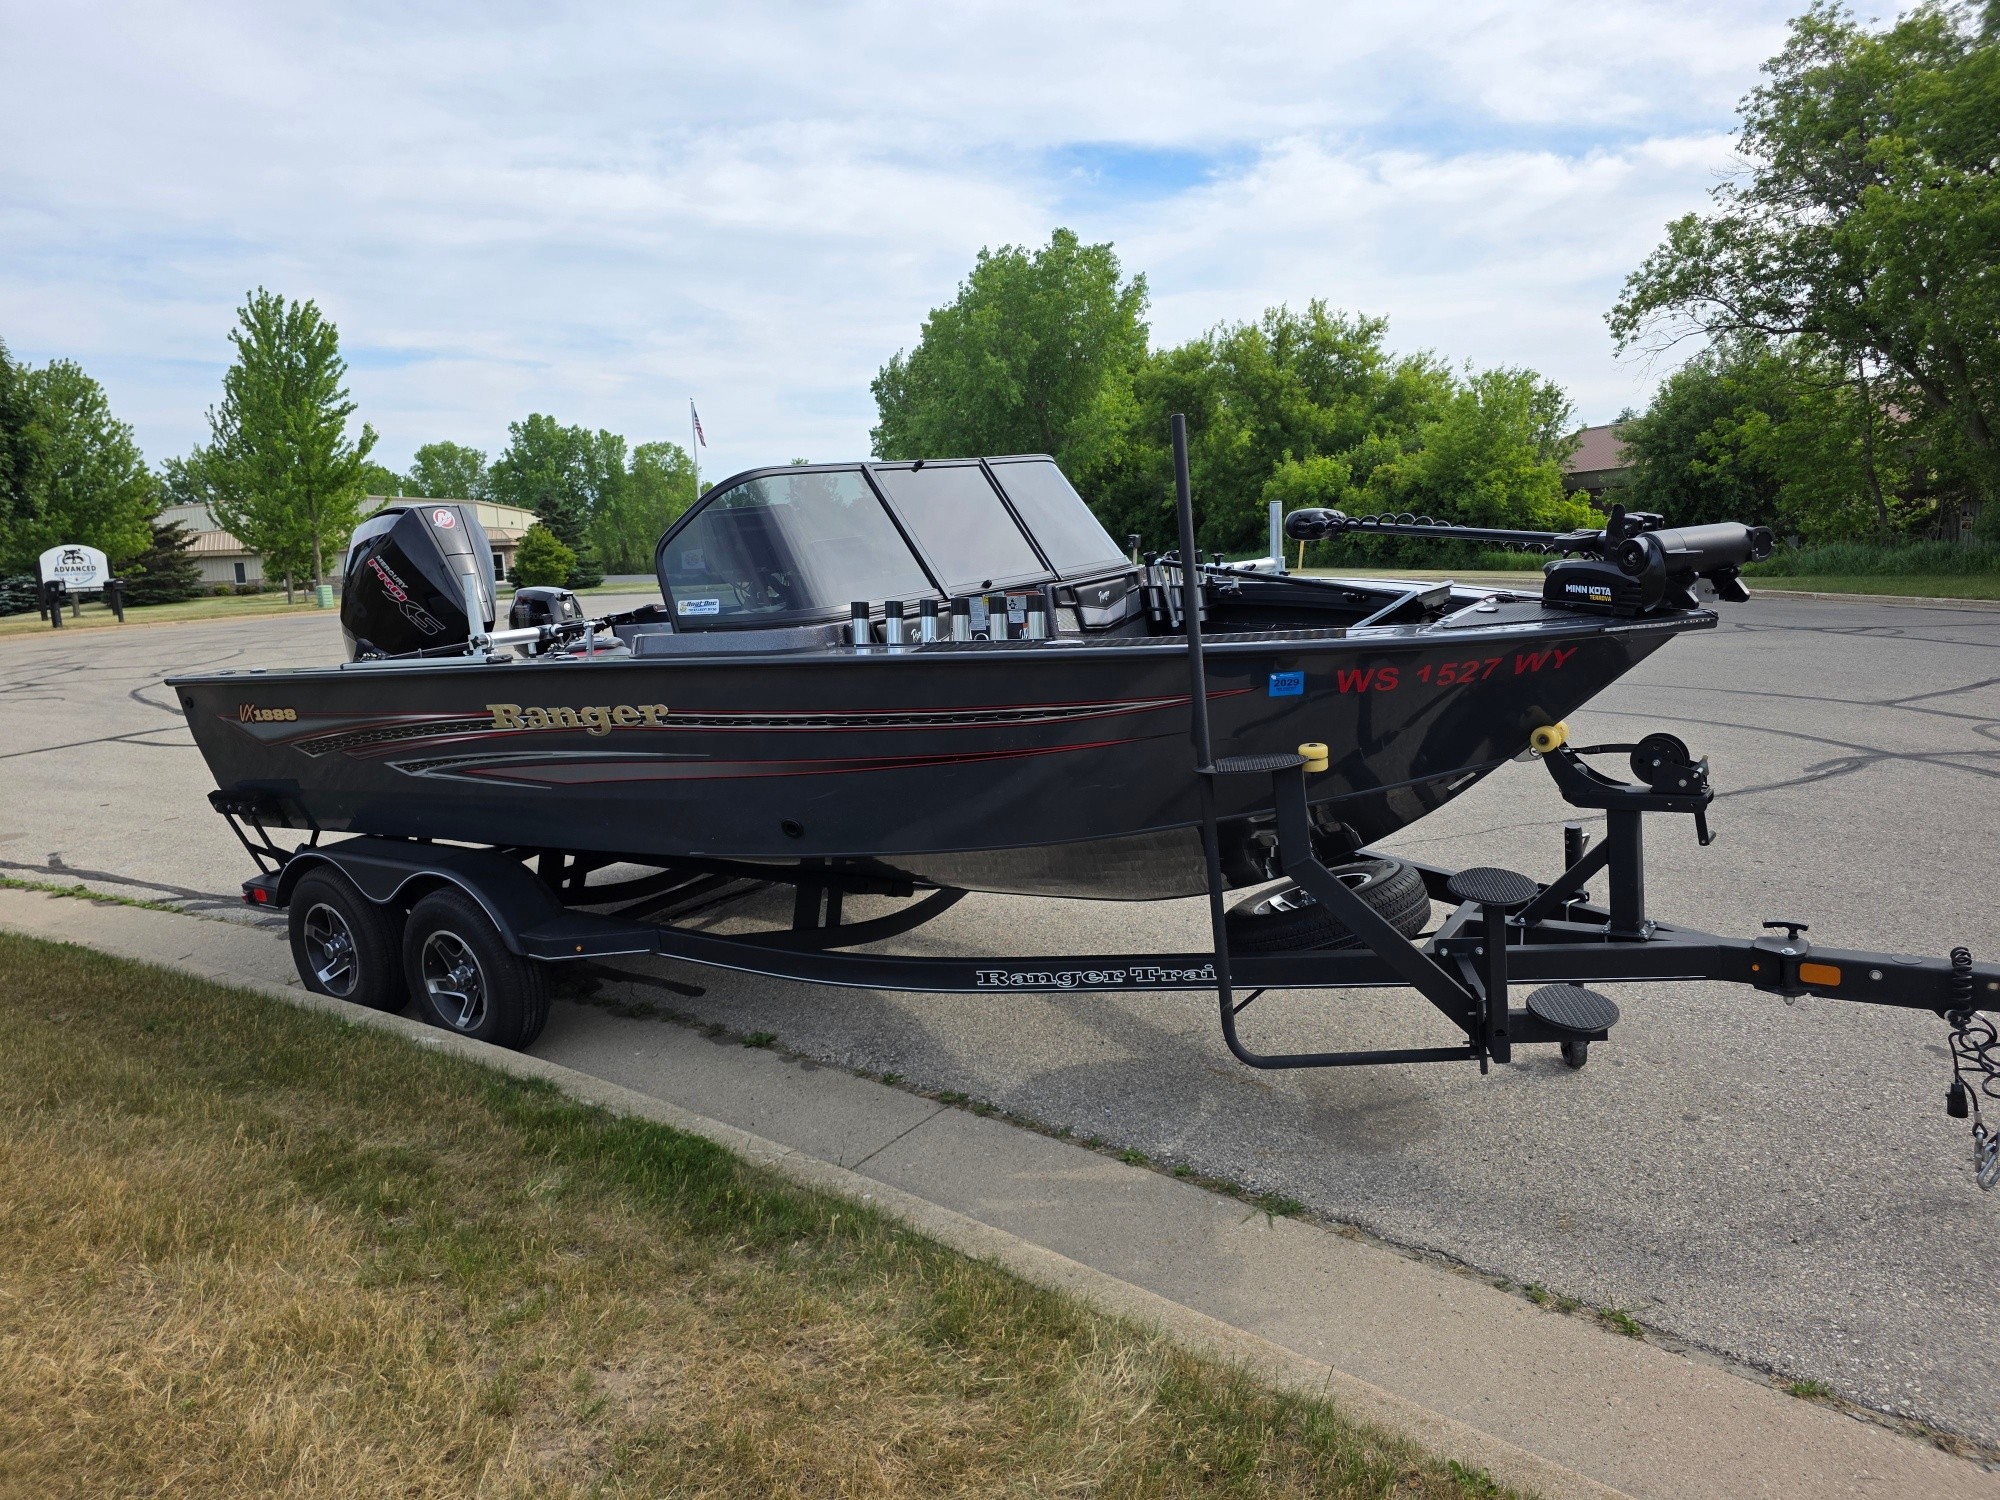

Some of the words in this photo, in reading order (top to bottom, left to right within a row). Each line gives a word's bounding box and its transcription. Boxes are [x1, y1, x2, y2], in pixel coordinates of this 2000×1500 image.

[54, 565, 97, 573] ADVANCED
[367, 558, 408, 602] PRO
[375, 555, 408, 589] MERCURY
[1565, 584, 1588, 594] MINN
[1588, 586, 1612, 596] KOTA
[382, 590, 446, 635] XS
[1274, 678, 1300, 687] 2029
[1337, 667, 1399, 693] WS
[1416, 657, 1503, 686] 1527
[1514, 647, 1578, 675] WY
[486, 703, 669, 737] Ranger
[976, 970, 1126, 988] Ranger
[1130, 964, 1230, 982] Trai
